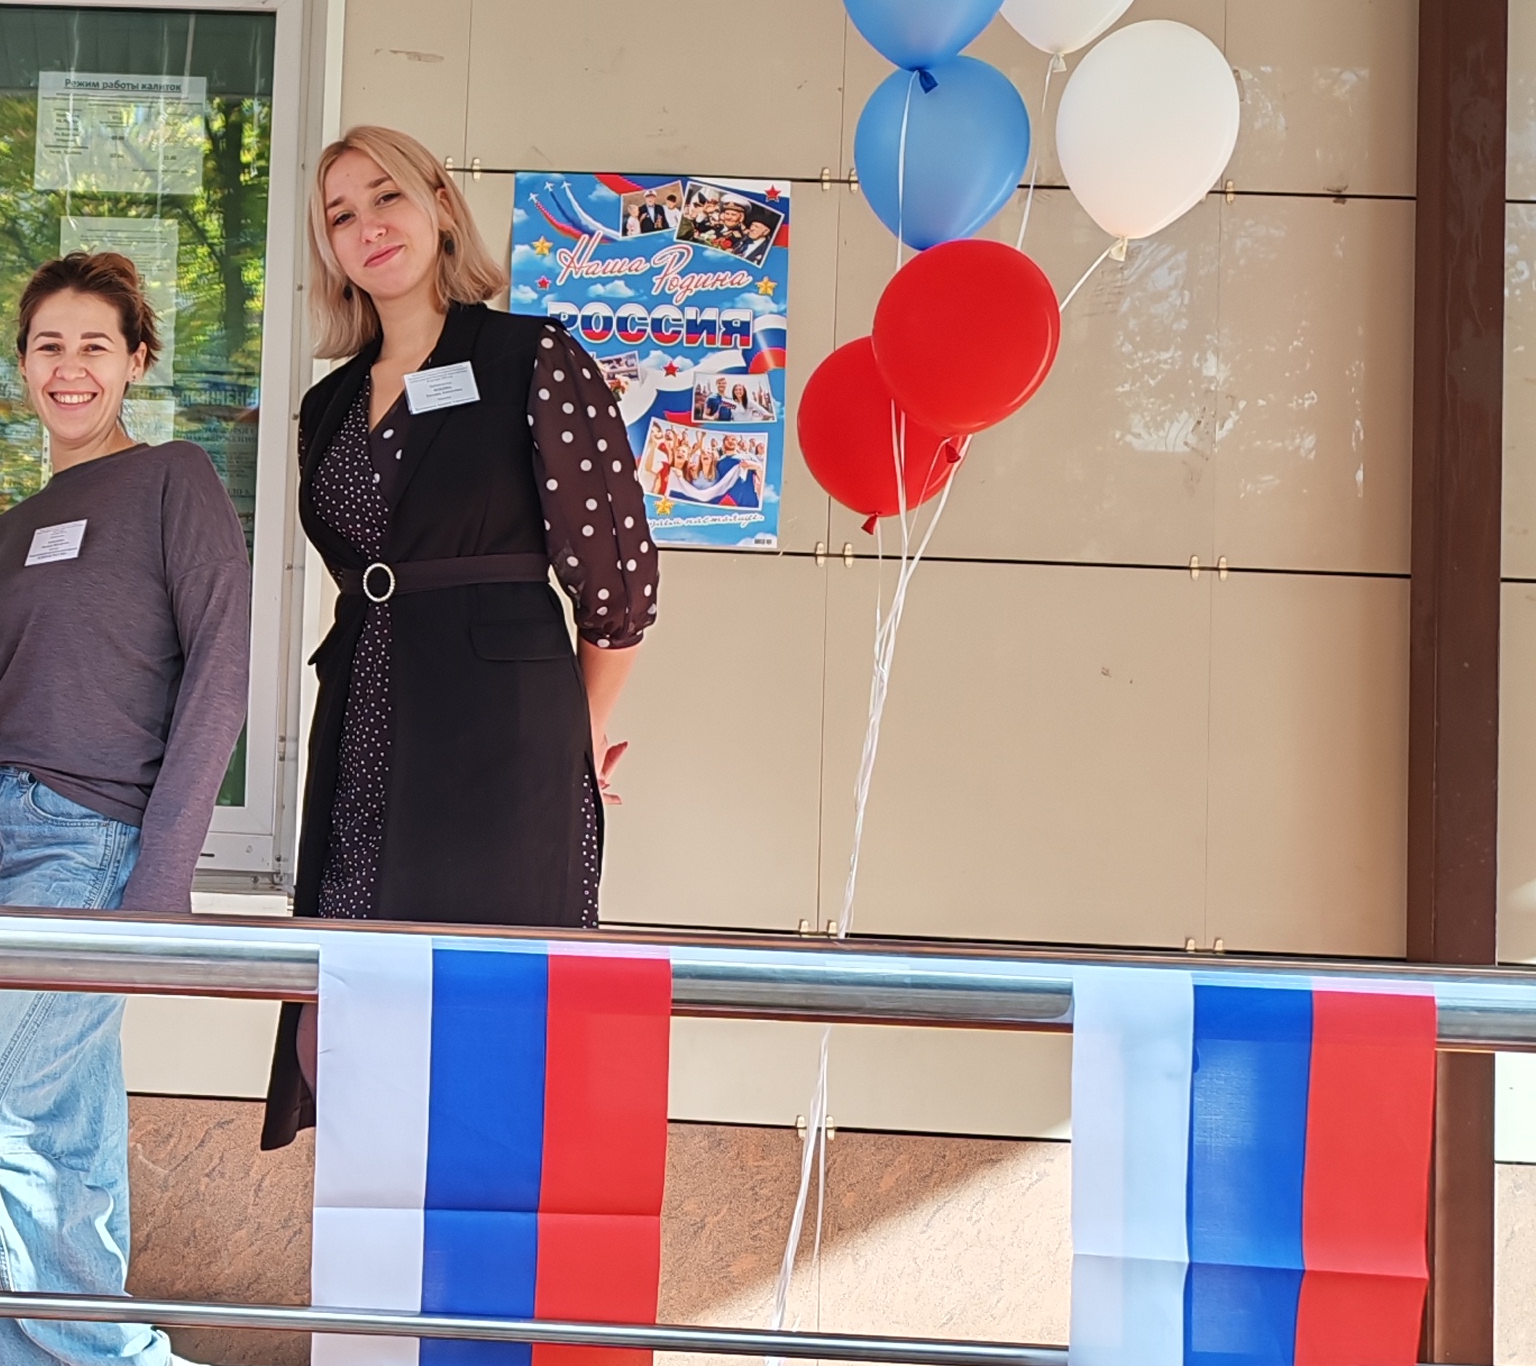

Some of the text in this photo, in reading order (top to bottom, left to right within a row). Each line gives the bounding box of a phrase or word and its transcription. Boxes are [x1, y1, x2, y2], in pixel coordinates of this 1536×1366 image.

[556, 230, 753, 305] Наша Родина
[547, 302, 754, 350] РОССИЯ
